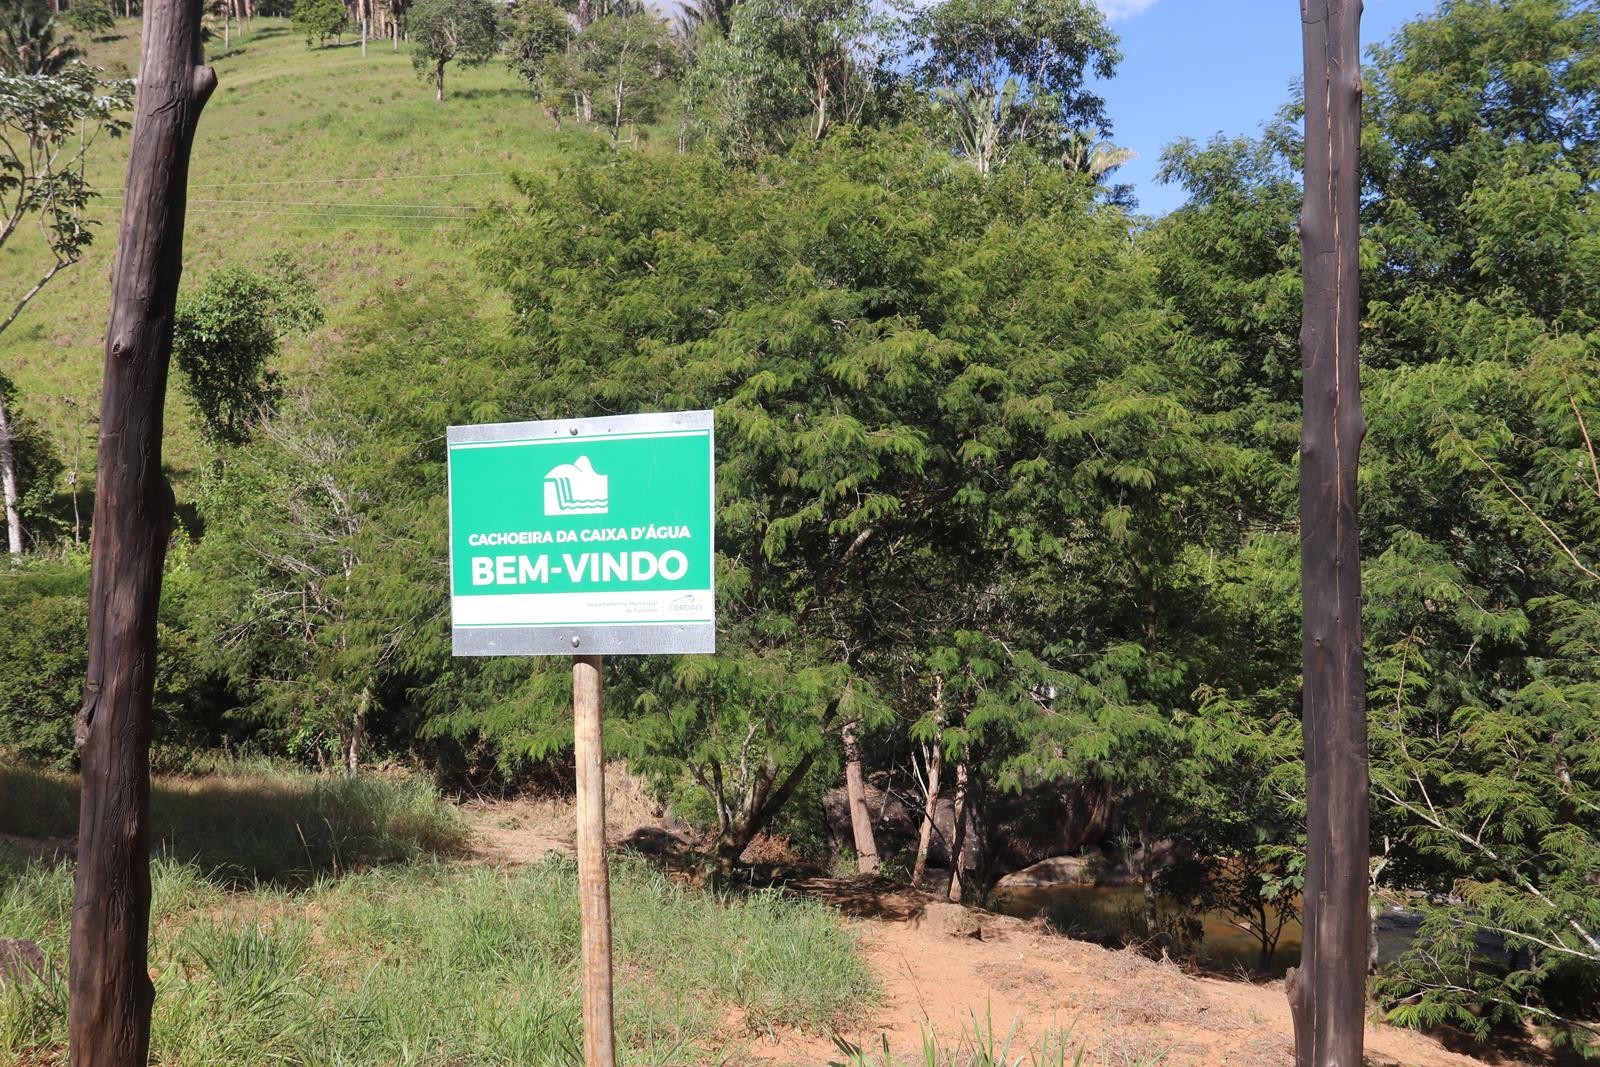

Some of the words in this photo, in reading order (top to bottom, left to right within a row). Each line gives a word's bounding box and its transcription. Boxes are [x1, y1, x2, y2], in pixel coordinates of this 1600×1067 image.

[468, 531, 554, 546] CACHOEIRA
[556, 530, 579, 543] DA
[580, 528, 628, 542] CAIXA
[471, 550, 689, 585] BEM-VINDO
